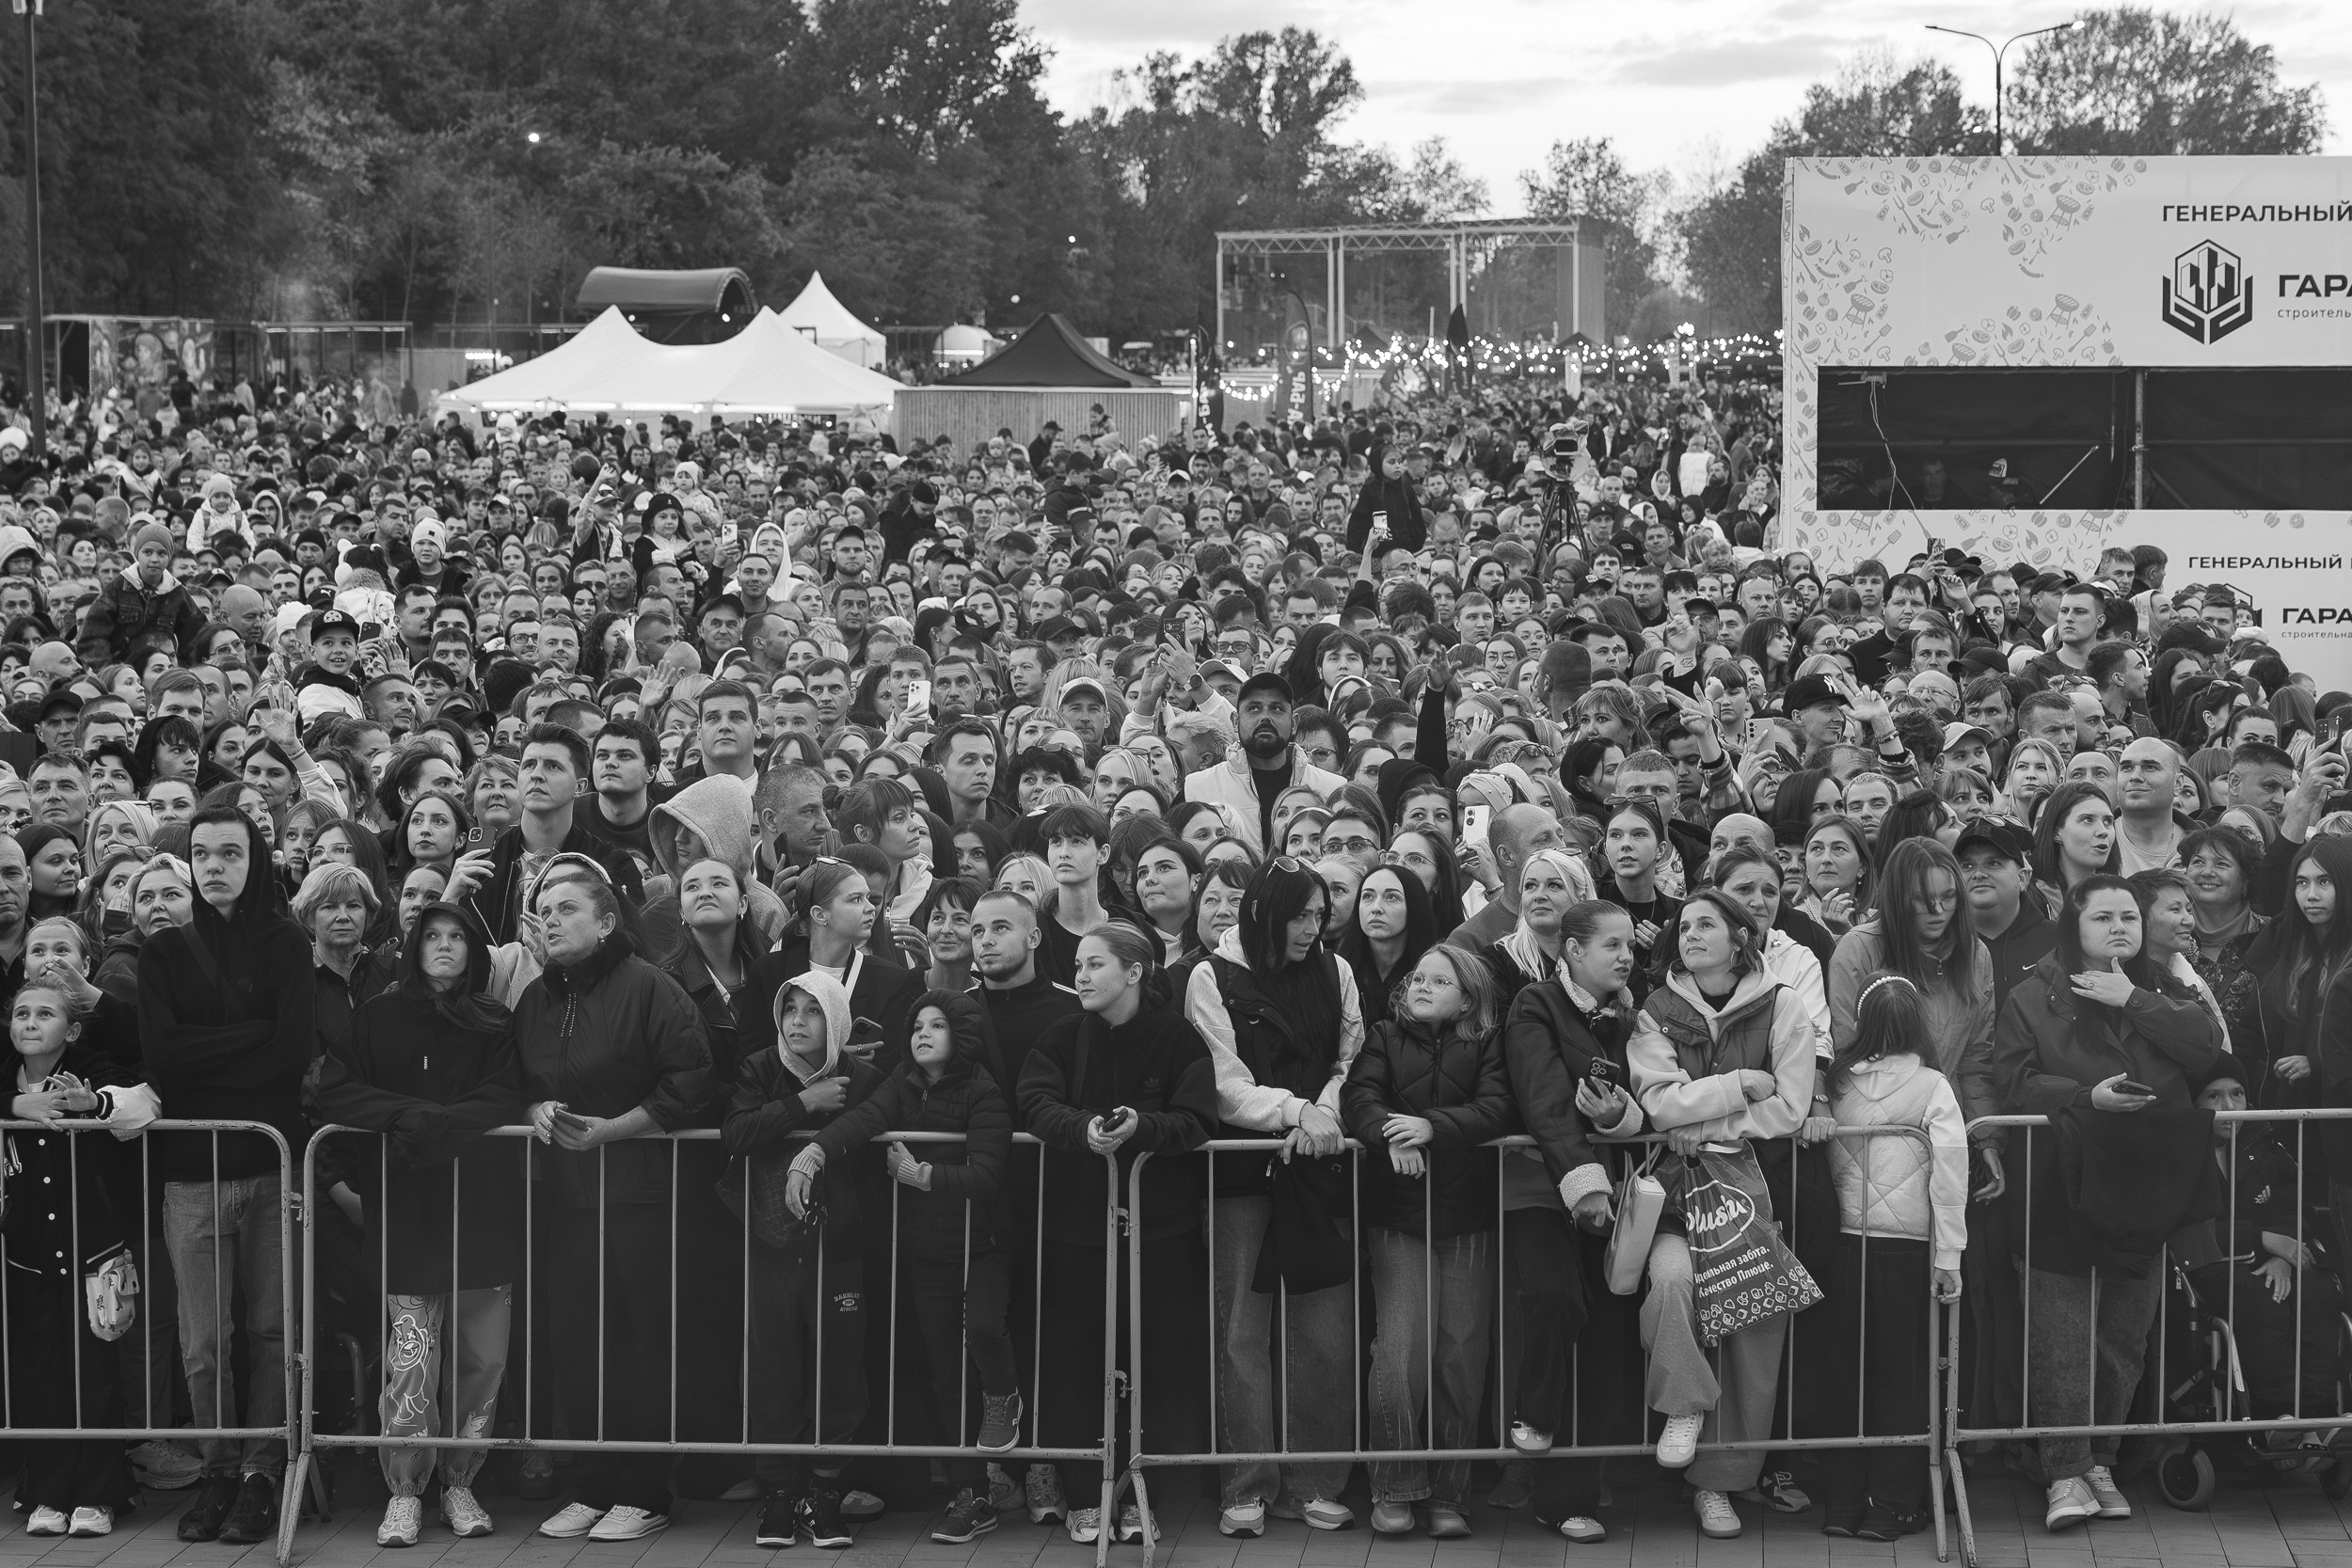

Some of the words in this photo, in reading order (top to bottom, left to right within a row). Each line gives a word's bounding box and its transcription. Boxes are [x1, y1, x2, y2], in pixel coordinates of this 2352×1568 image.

[2162, 200, 2352, 222] ГЕНЕРАЛЬНЫЙ
[2279, 274, 2352, 298] ГАР
[2278, 309, 2352, 320] строитель
[2188, 553, 2343, 569] ГЕНЕРАЛЬНЫЙ
